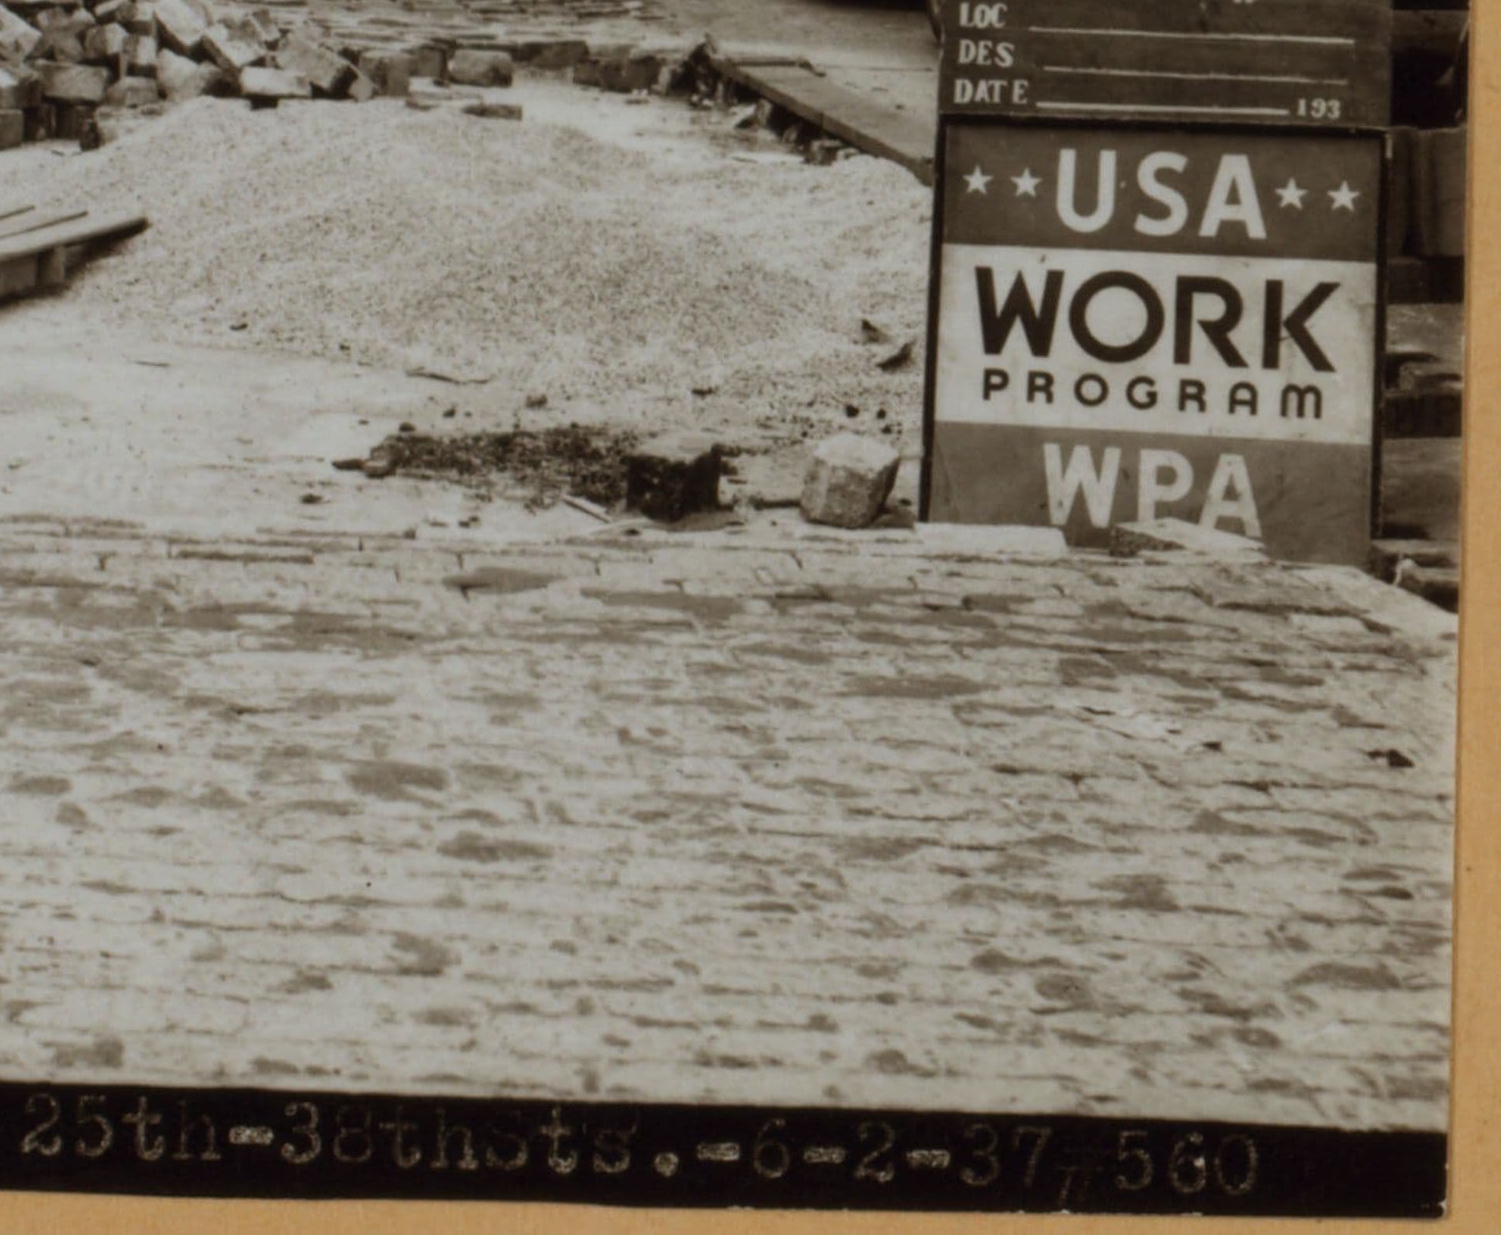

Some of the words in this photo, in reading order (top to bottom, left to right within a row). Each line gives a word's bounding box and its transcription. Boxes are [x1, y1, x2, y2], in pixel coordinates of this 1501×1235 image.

[958, 2, 1008, 28] LOC
[957, 41, 1015, 68] DES
[954, 78, 1030, 106] DATE
[1297, 97, 1342, 120] 193
[1055, 147, 1268, 241] USA
[974, 265, 1342, 373] WORK
[981, 369, 1324, 421] PROGRAM
[1043, 441, 1262, 539] WPA
